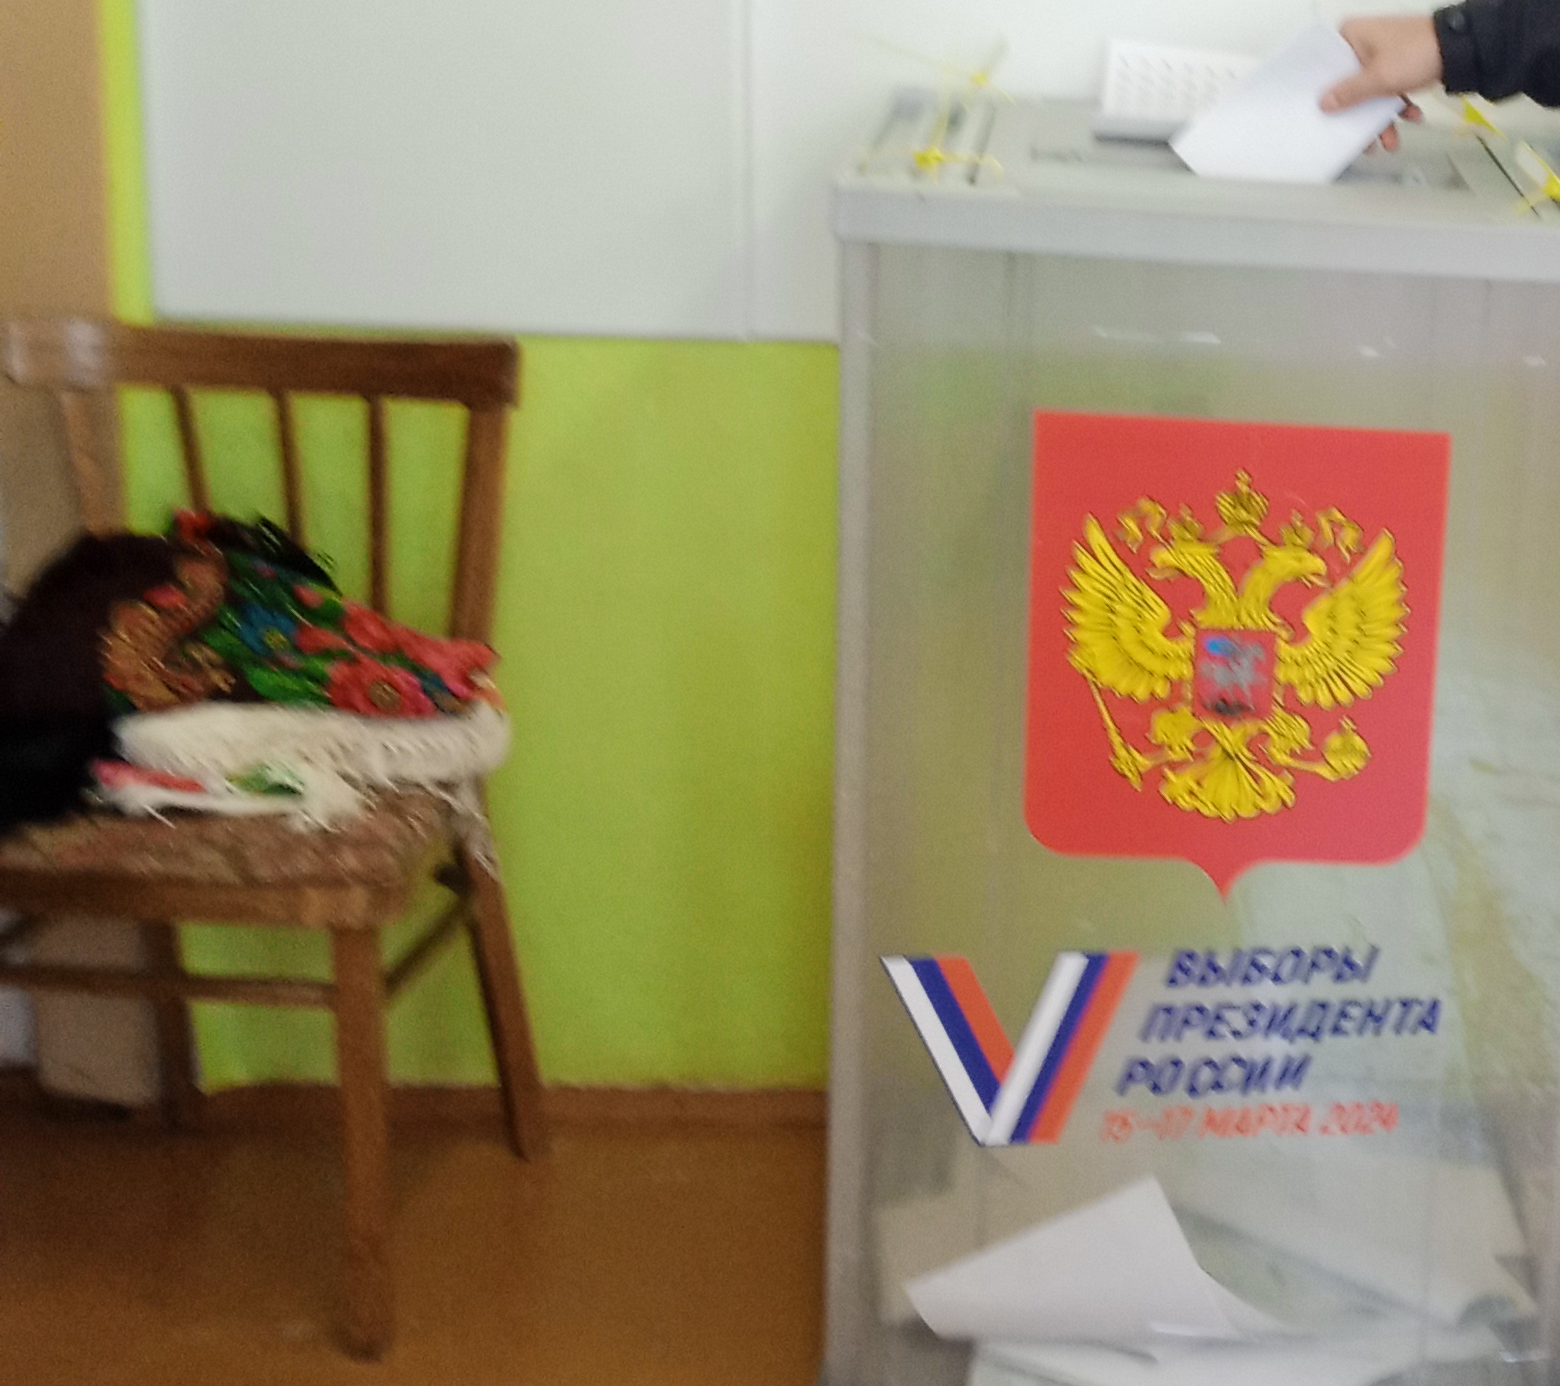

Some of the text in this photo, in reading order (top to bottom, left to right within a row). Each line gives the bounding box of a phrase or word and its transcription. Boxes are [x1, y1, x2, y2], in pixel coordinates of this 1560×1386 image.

[1165, 945, 1379, 988] ВЫБОРЫ
[1138, 999, 1441, 1044] ПРЕЗИДЕНТА
[1114, 1054, 1312, 1099] РОССИИ
[1197, 1103, 1312, 1138] МАРТА
